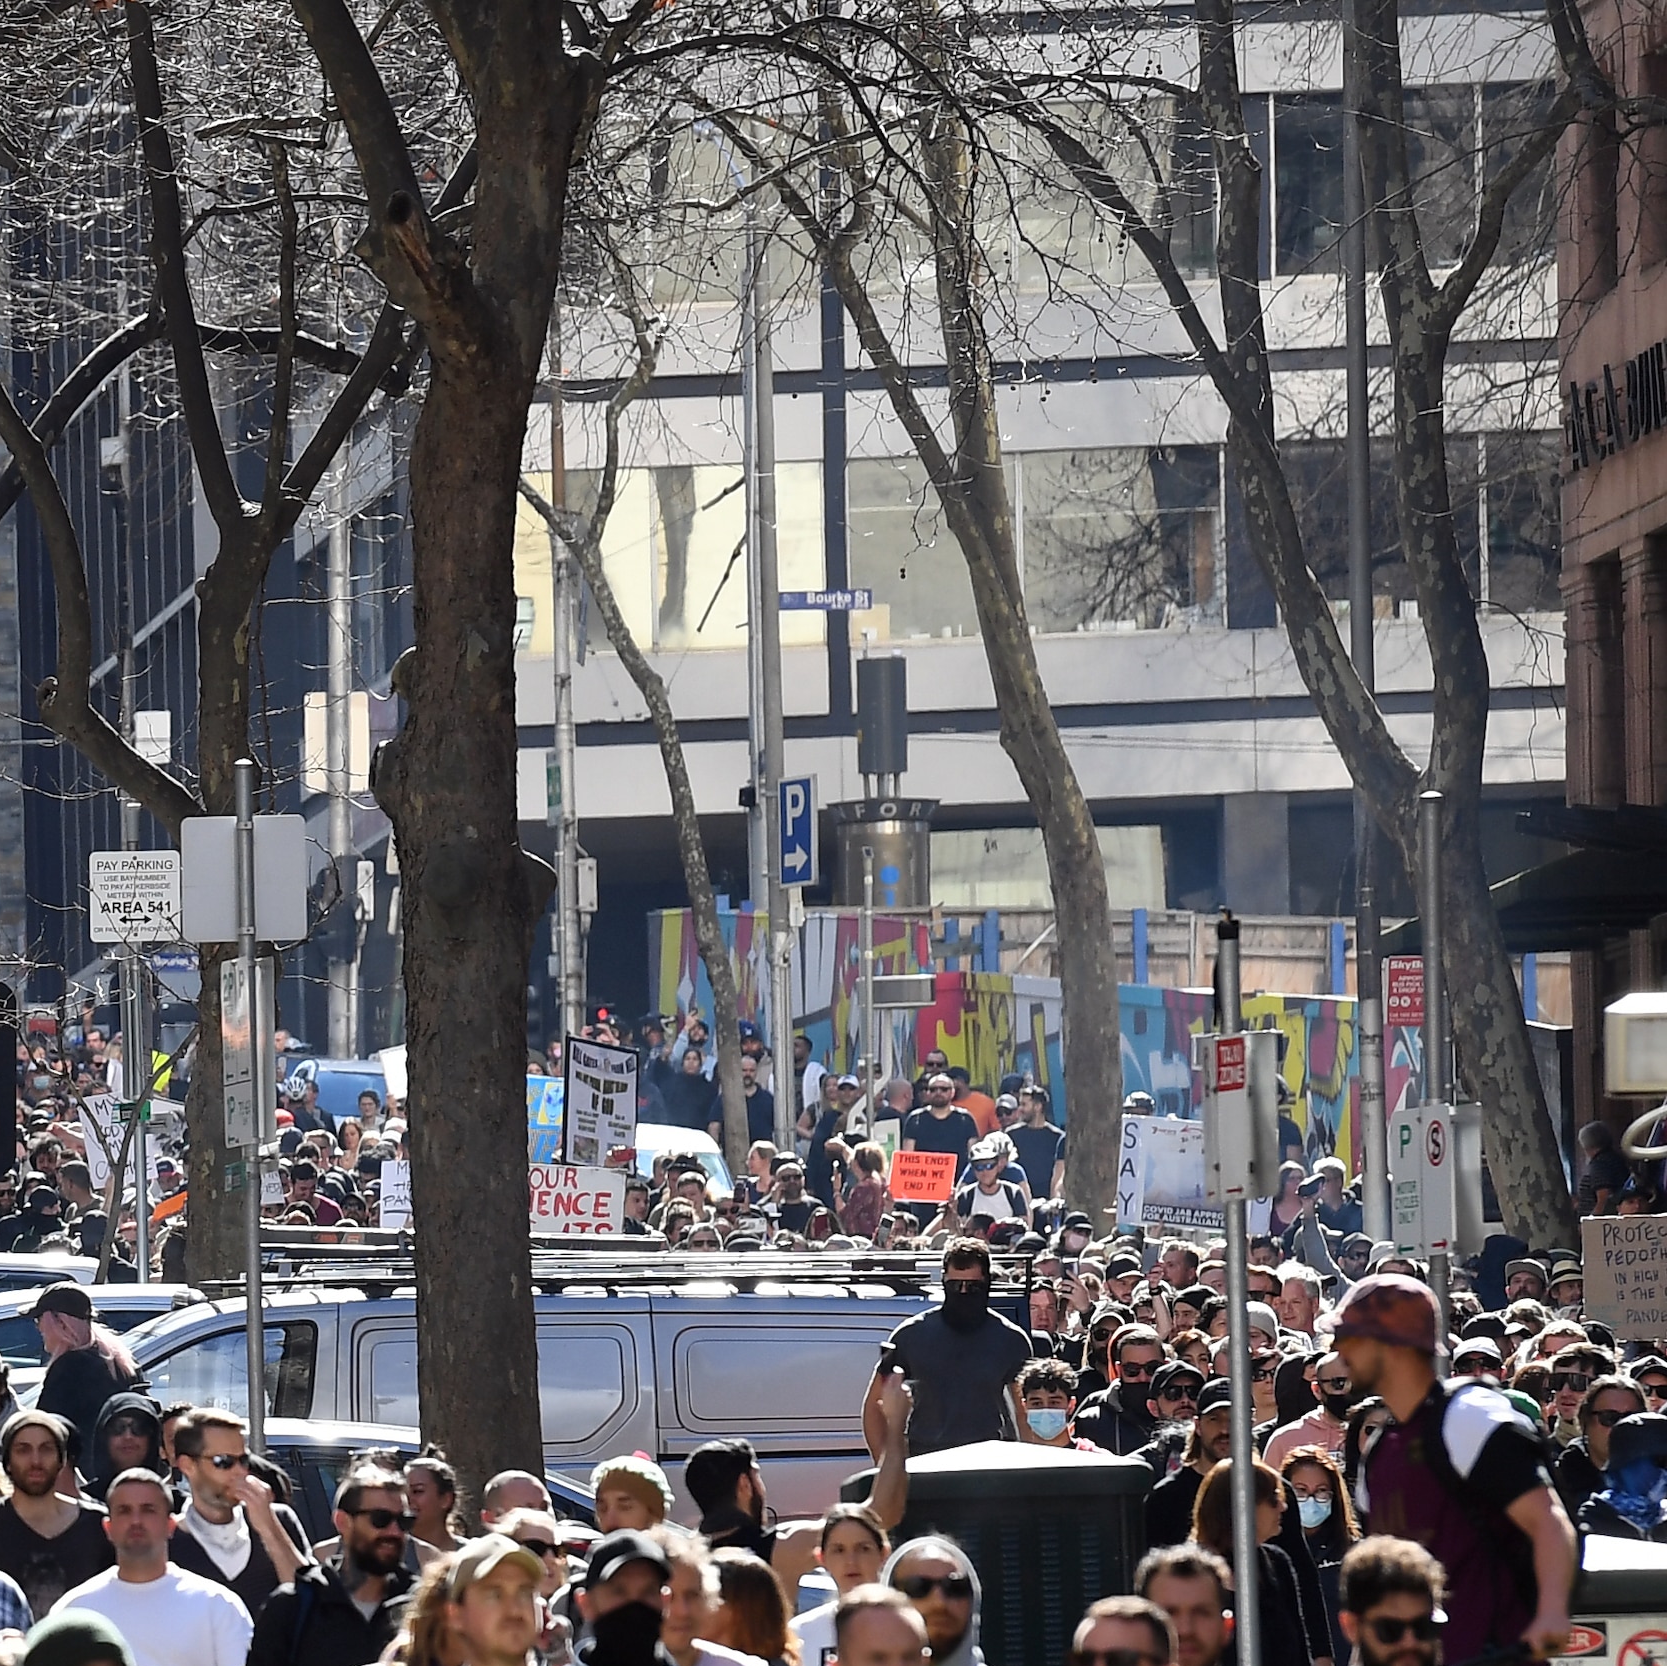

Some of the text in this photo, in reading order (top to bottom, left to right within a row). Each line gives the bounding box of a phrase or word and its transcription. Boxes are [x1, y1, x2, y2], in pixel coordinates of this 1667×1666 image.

[806, 590, 852, 605] Bourke
[854, 590, 869, 602] St
[785, 783, 806, 837] P
[96, 860, 174, 871] PAY PARKING
[100, 900, 171, 914] AREA 541
[1399, 1124, 1412, 1158] P
[899, 1154, 950, 1166] THIS ENDS
[529, 1167, 579, 1190] OUR
[899, 1167, 945, 1180] WHEN WE
[903, 1181, 937, 1191] END IT
[529, 1191, 613, 1219] IENCE
[1143, 1205, 1174, 1215] COVID
[1174, 1208, 1193, 1217] JAB
[1142, 1213, 1220, 1227] FOR AUSTRALIAN
[1614, 1270, 1659, 1286] IN HIGH
[1631, 1286, 1655, 1300] THE
